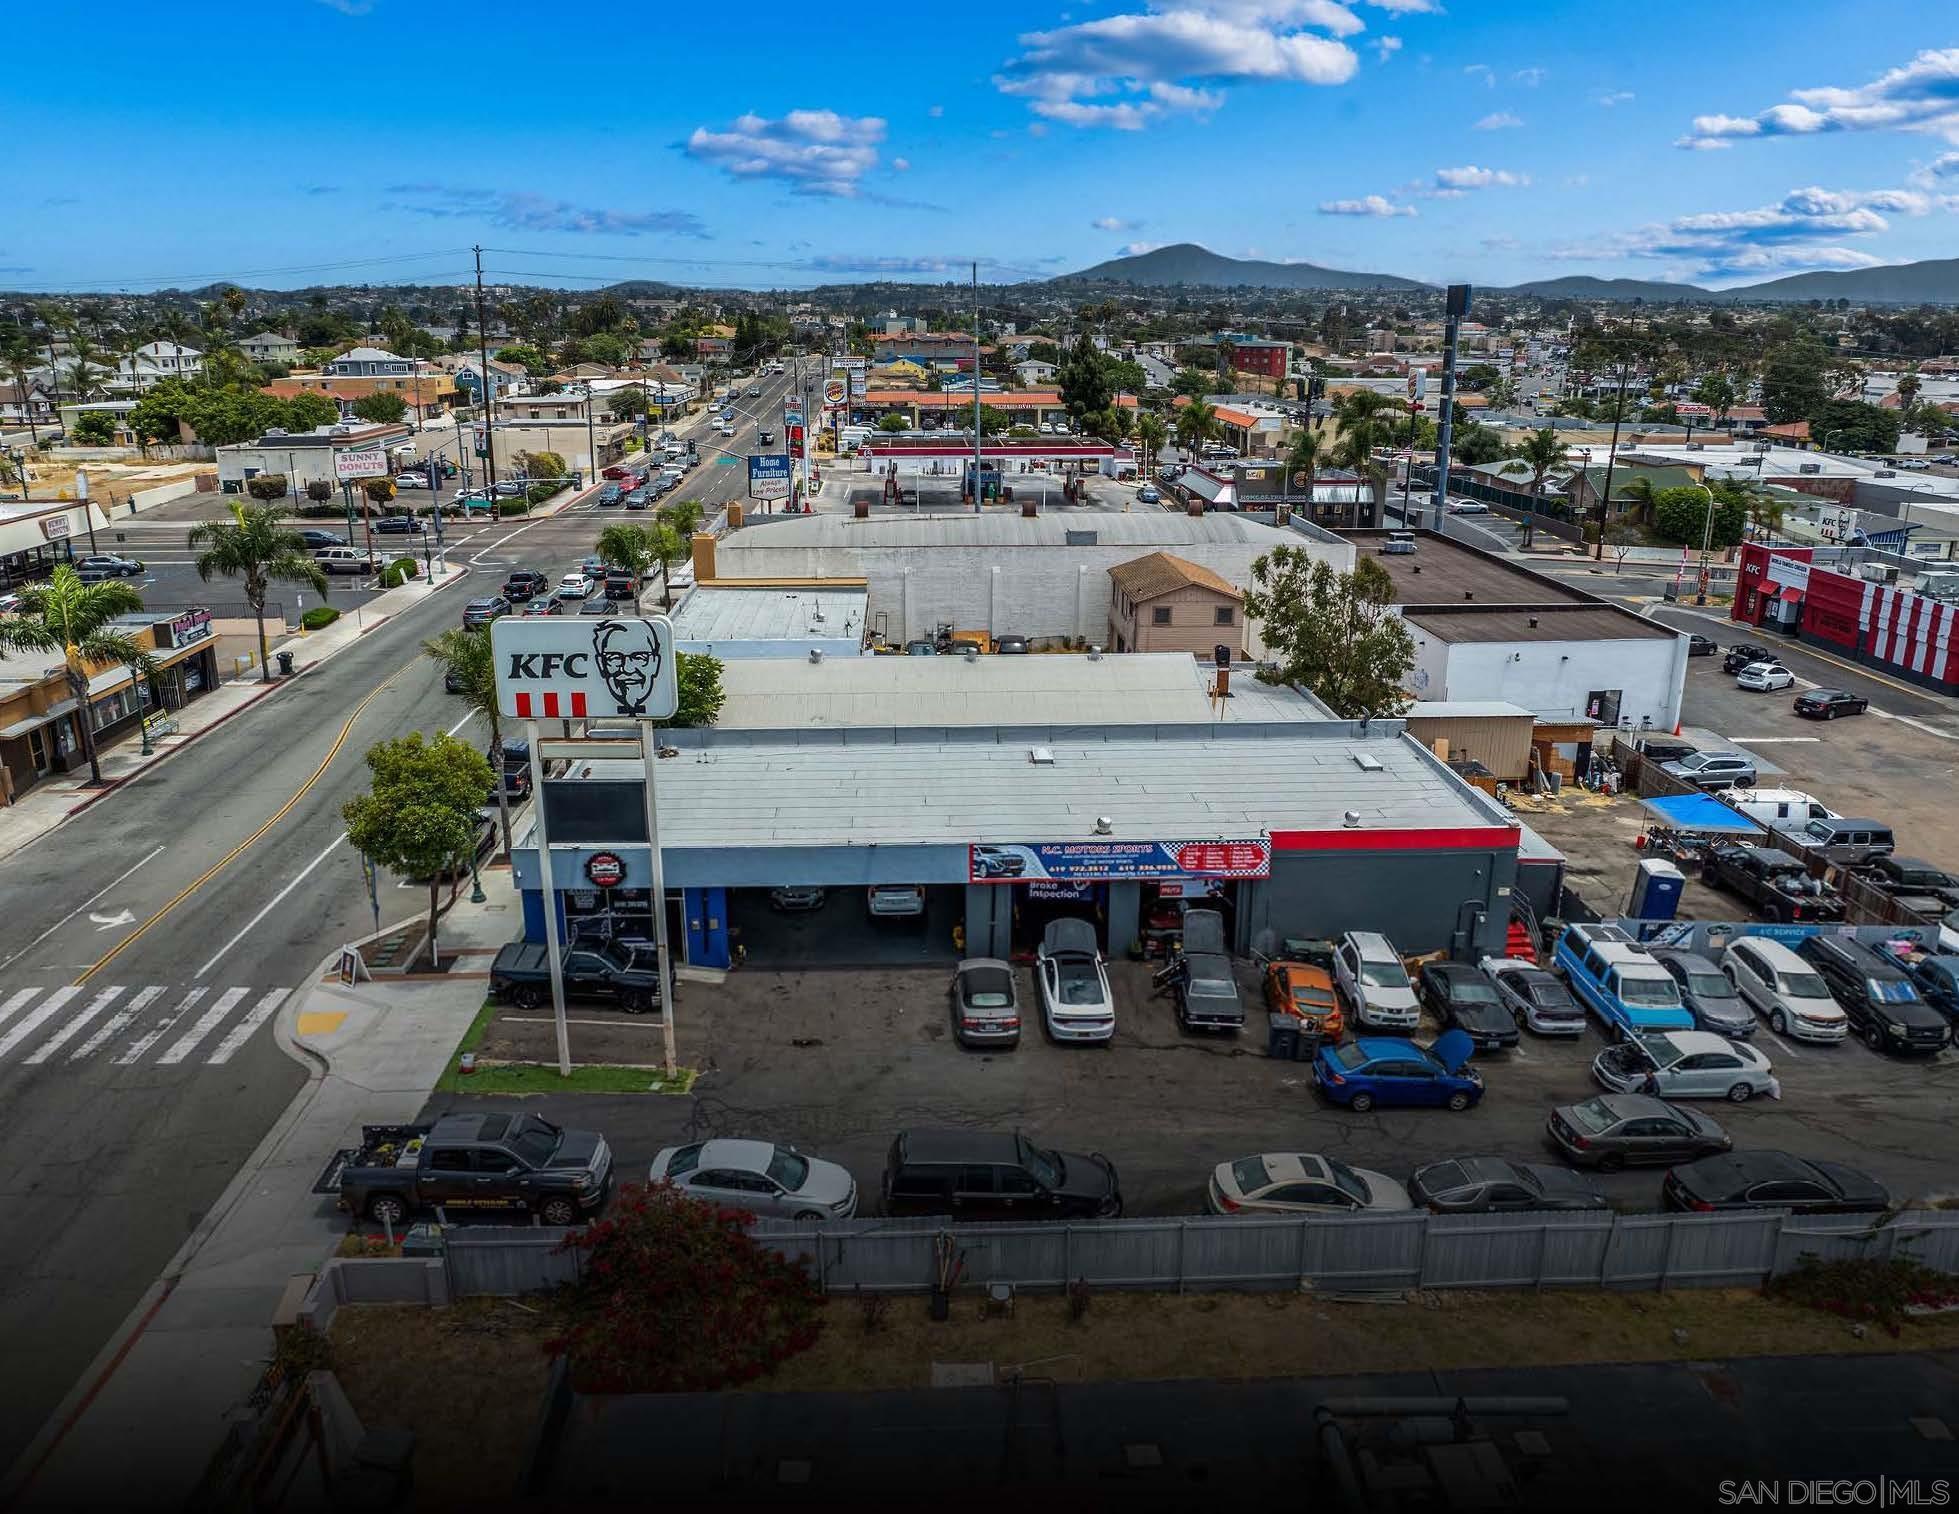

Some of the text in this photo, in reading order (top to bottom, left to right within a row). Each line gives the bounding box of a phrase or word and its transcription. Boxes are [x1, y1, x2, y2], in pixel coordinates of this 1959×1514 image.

[341, 453, 380, 462] SUNNY
[760, 457, 780, 466] Home
[339, 462, 385, 471] DONUTS
[752, 467, 788, 478] Furniture
[1822, 517, 1837, 527] KFC
[1745, 563, 1760, 575] KFC
[508, 653, 589, 679] KFC
[1112, 844, 1154, 853] SPORTS
[1029, 889, 1080, 899] Inspection
[1774, 927, 1806, 936] SERVICE
